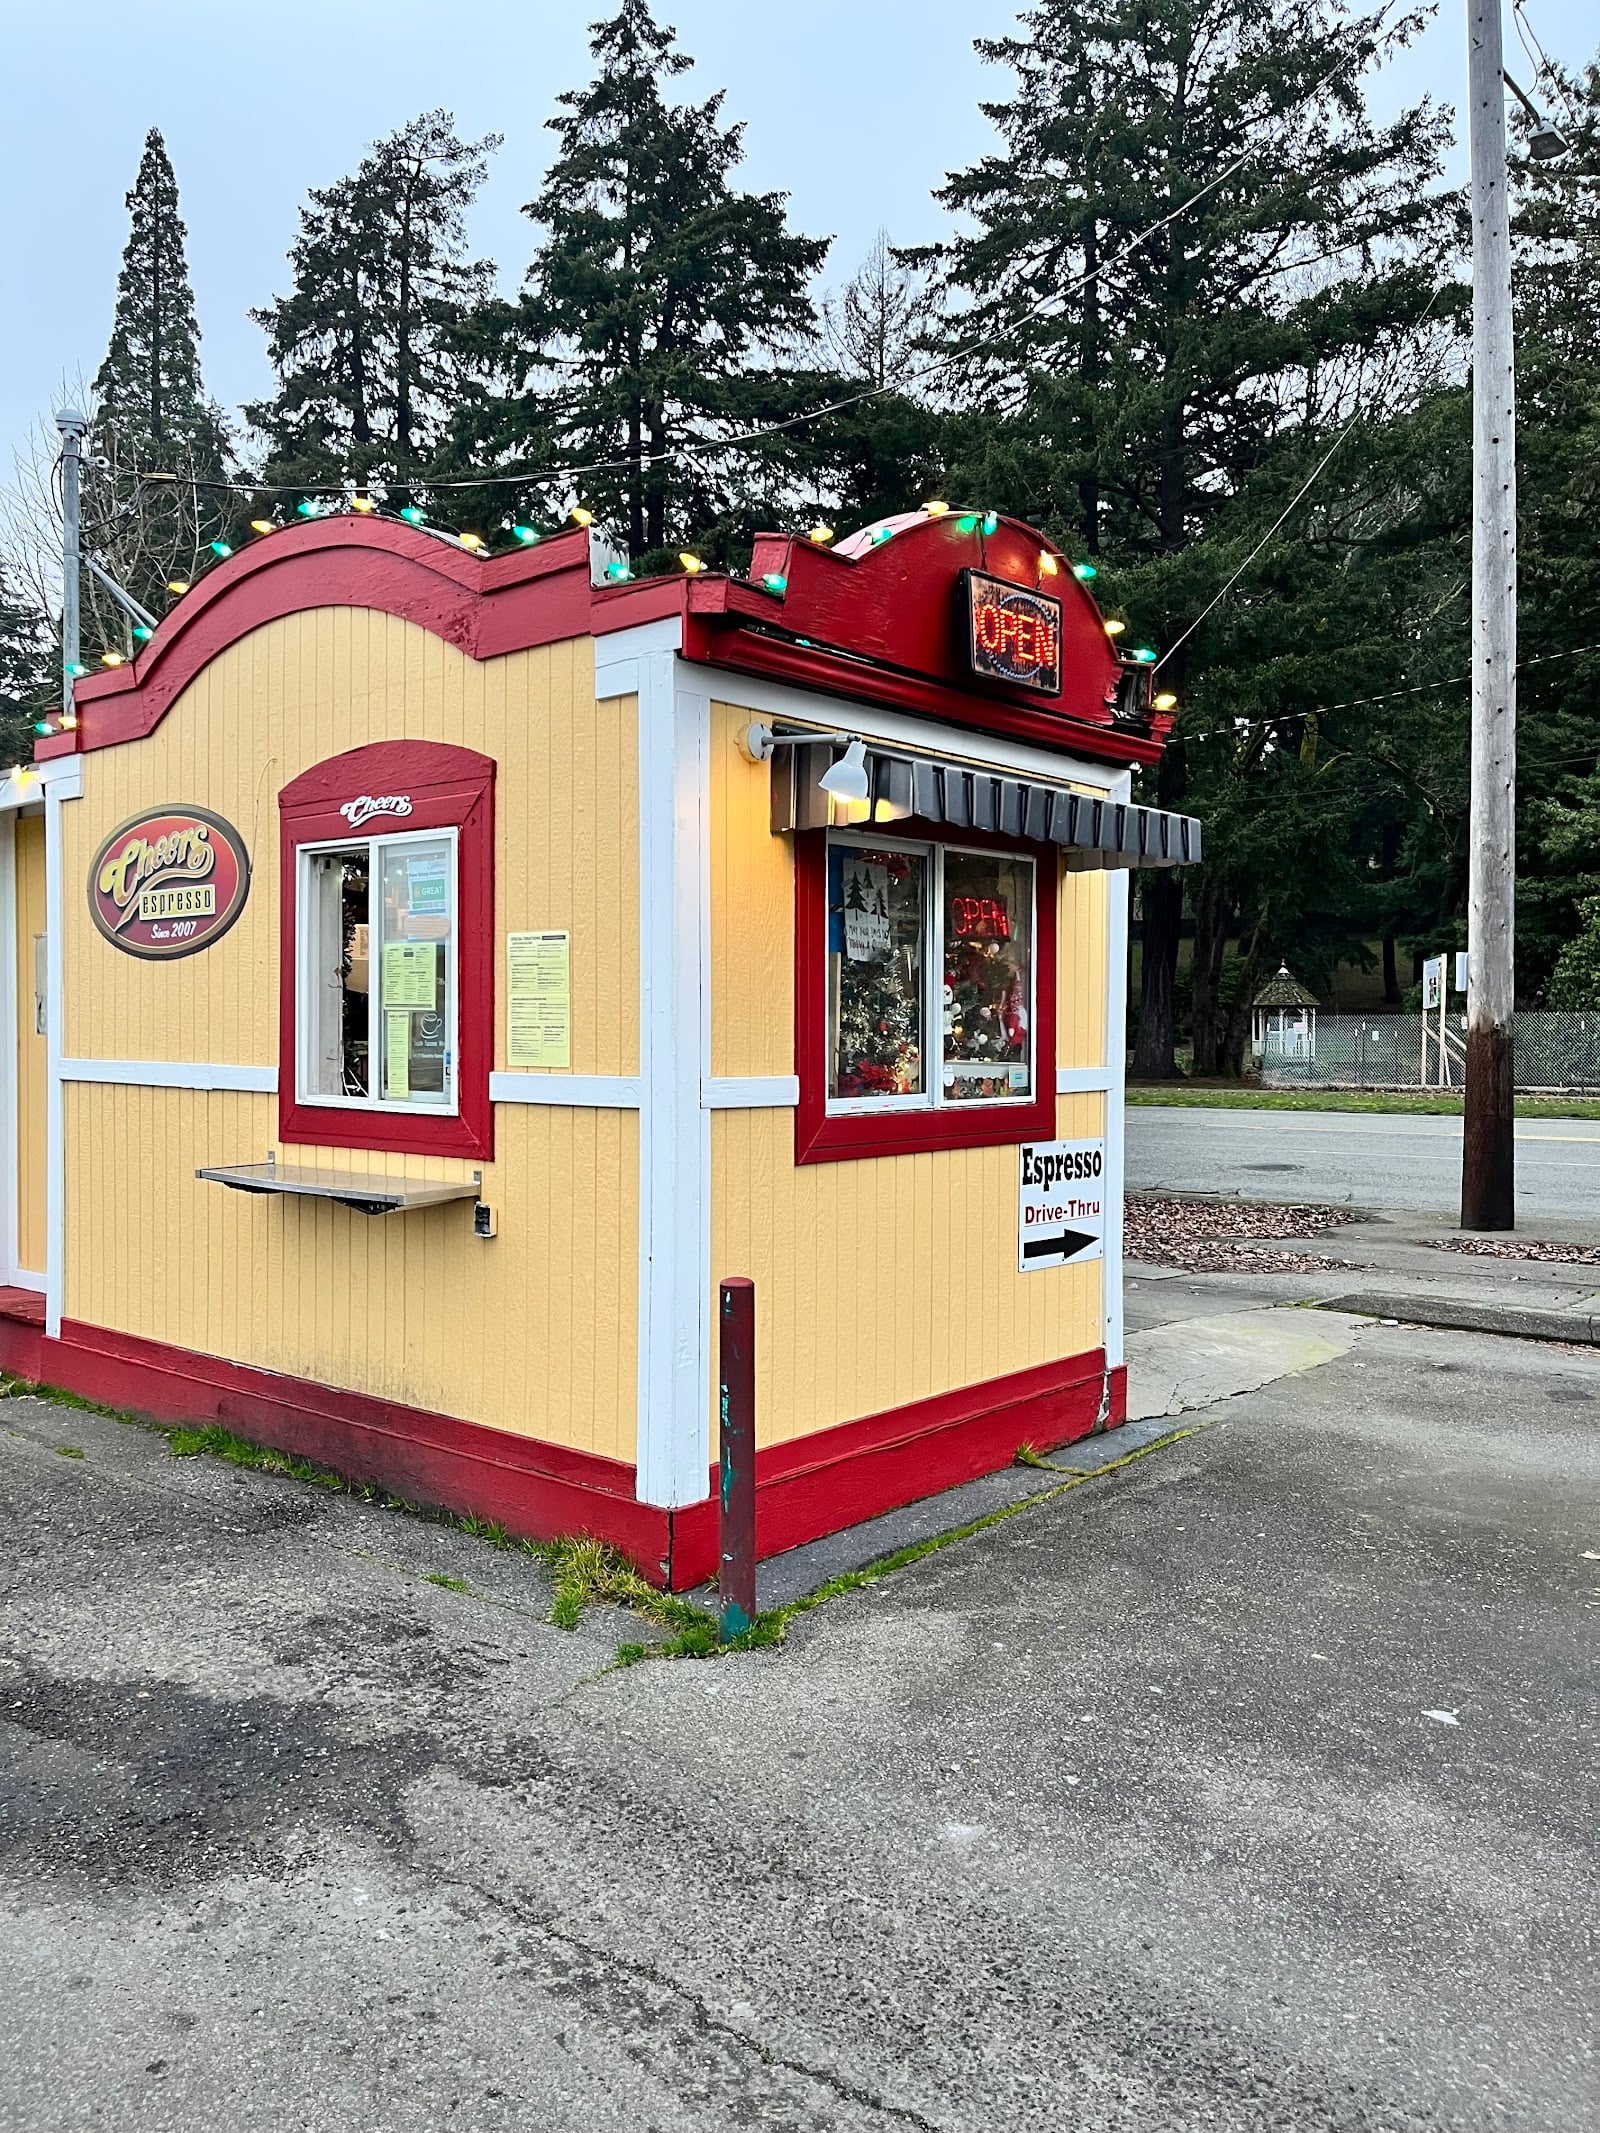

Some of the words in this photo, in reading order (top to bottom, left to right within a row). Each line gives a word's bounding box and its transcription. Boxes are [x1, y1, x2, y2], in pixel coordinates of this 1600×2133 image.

[979, 604, 1054, 667] OPEN
[340, 796, 413, 829] Cheers
[99, 825, 214, 924] Cheers
[421, 886, 443, 896] GREAT
[143, 889, 211, 915] espresso
[951, 897, 1009, 936] OPEN
[151, 923, 170, 939] Since
[171, 921, 197, 938] 2007
[1022, 1147, 1102, 1192] Espresso
[1025, 1199, 1100, 1224] Drive-Thru
